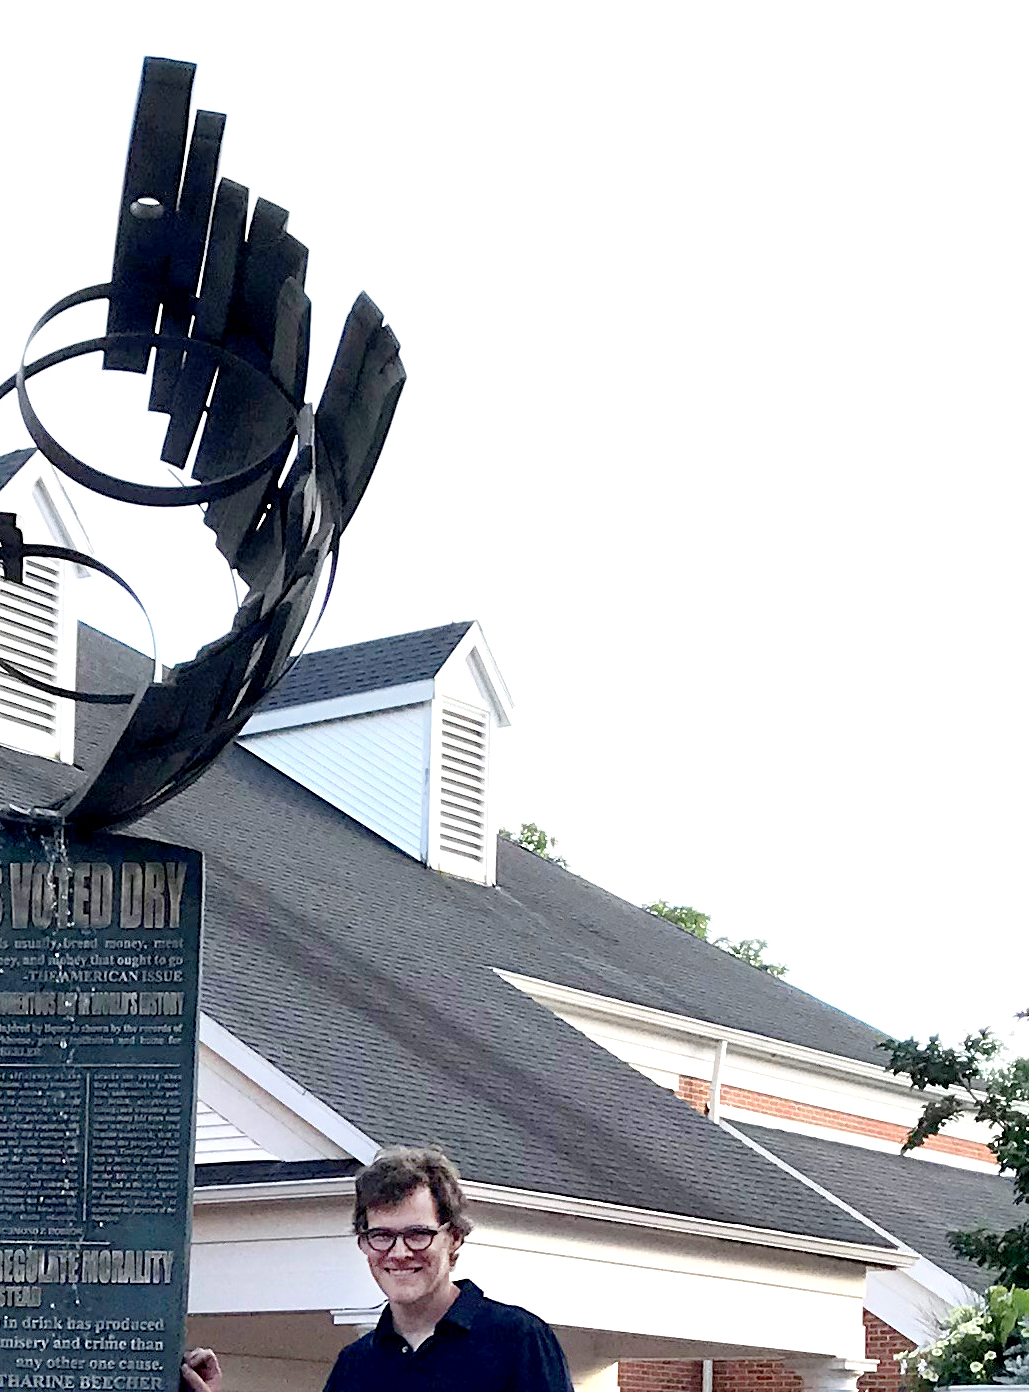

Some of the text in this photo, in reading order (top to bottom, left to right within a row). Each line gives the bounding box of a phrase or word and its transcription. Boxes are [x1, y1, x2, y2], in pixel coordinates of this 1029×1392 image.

[10, 862, 113, 930] VOTED
[120, 861, 186, 930] DRY
[22, 954, 44, 966] and
[90, 954, 114, 966] that
[117, 954, 151, 968] ought
[153, 955, 165, 966] to
[168, 957, 183, 968] go
[61, 970, 138, 983] AMERICAN
[142, 970, 183, 983] ISSUE
[82, 1250, 173, 1284] MORALITY
[3, 1315, 17, 1329] in
[22, 1316, 63, 1330] drink
[67, 1316, 92, 1330] has
[95, 1317, 165, 1333] produced
[0, 1336, 49, 1351] misery
[53, 1337, 80, 1349] and
[85, 1337, 127, 1350] crime
[130, 1338, 164, 1350] than
[15, 1356, 164, 1371] any other one cause.
